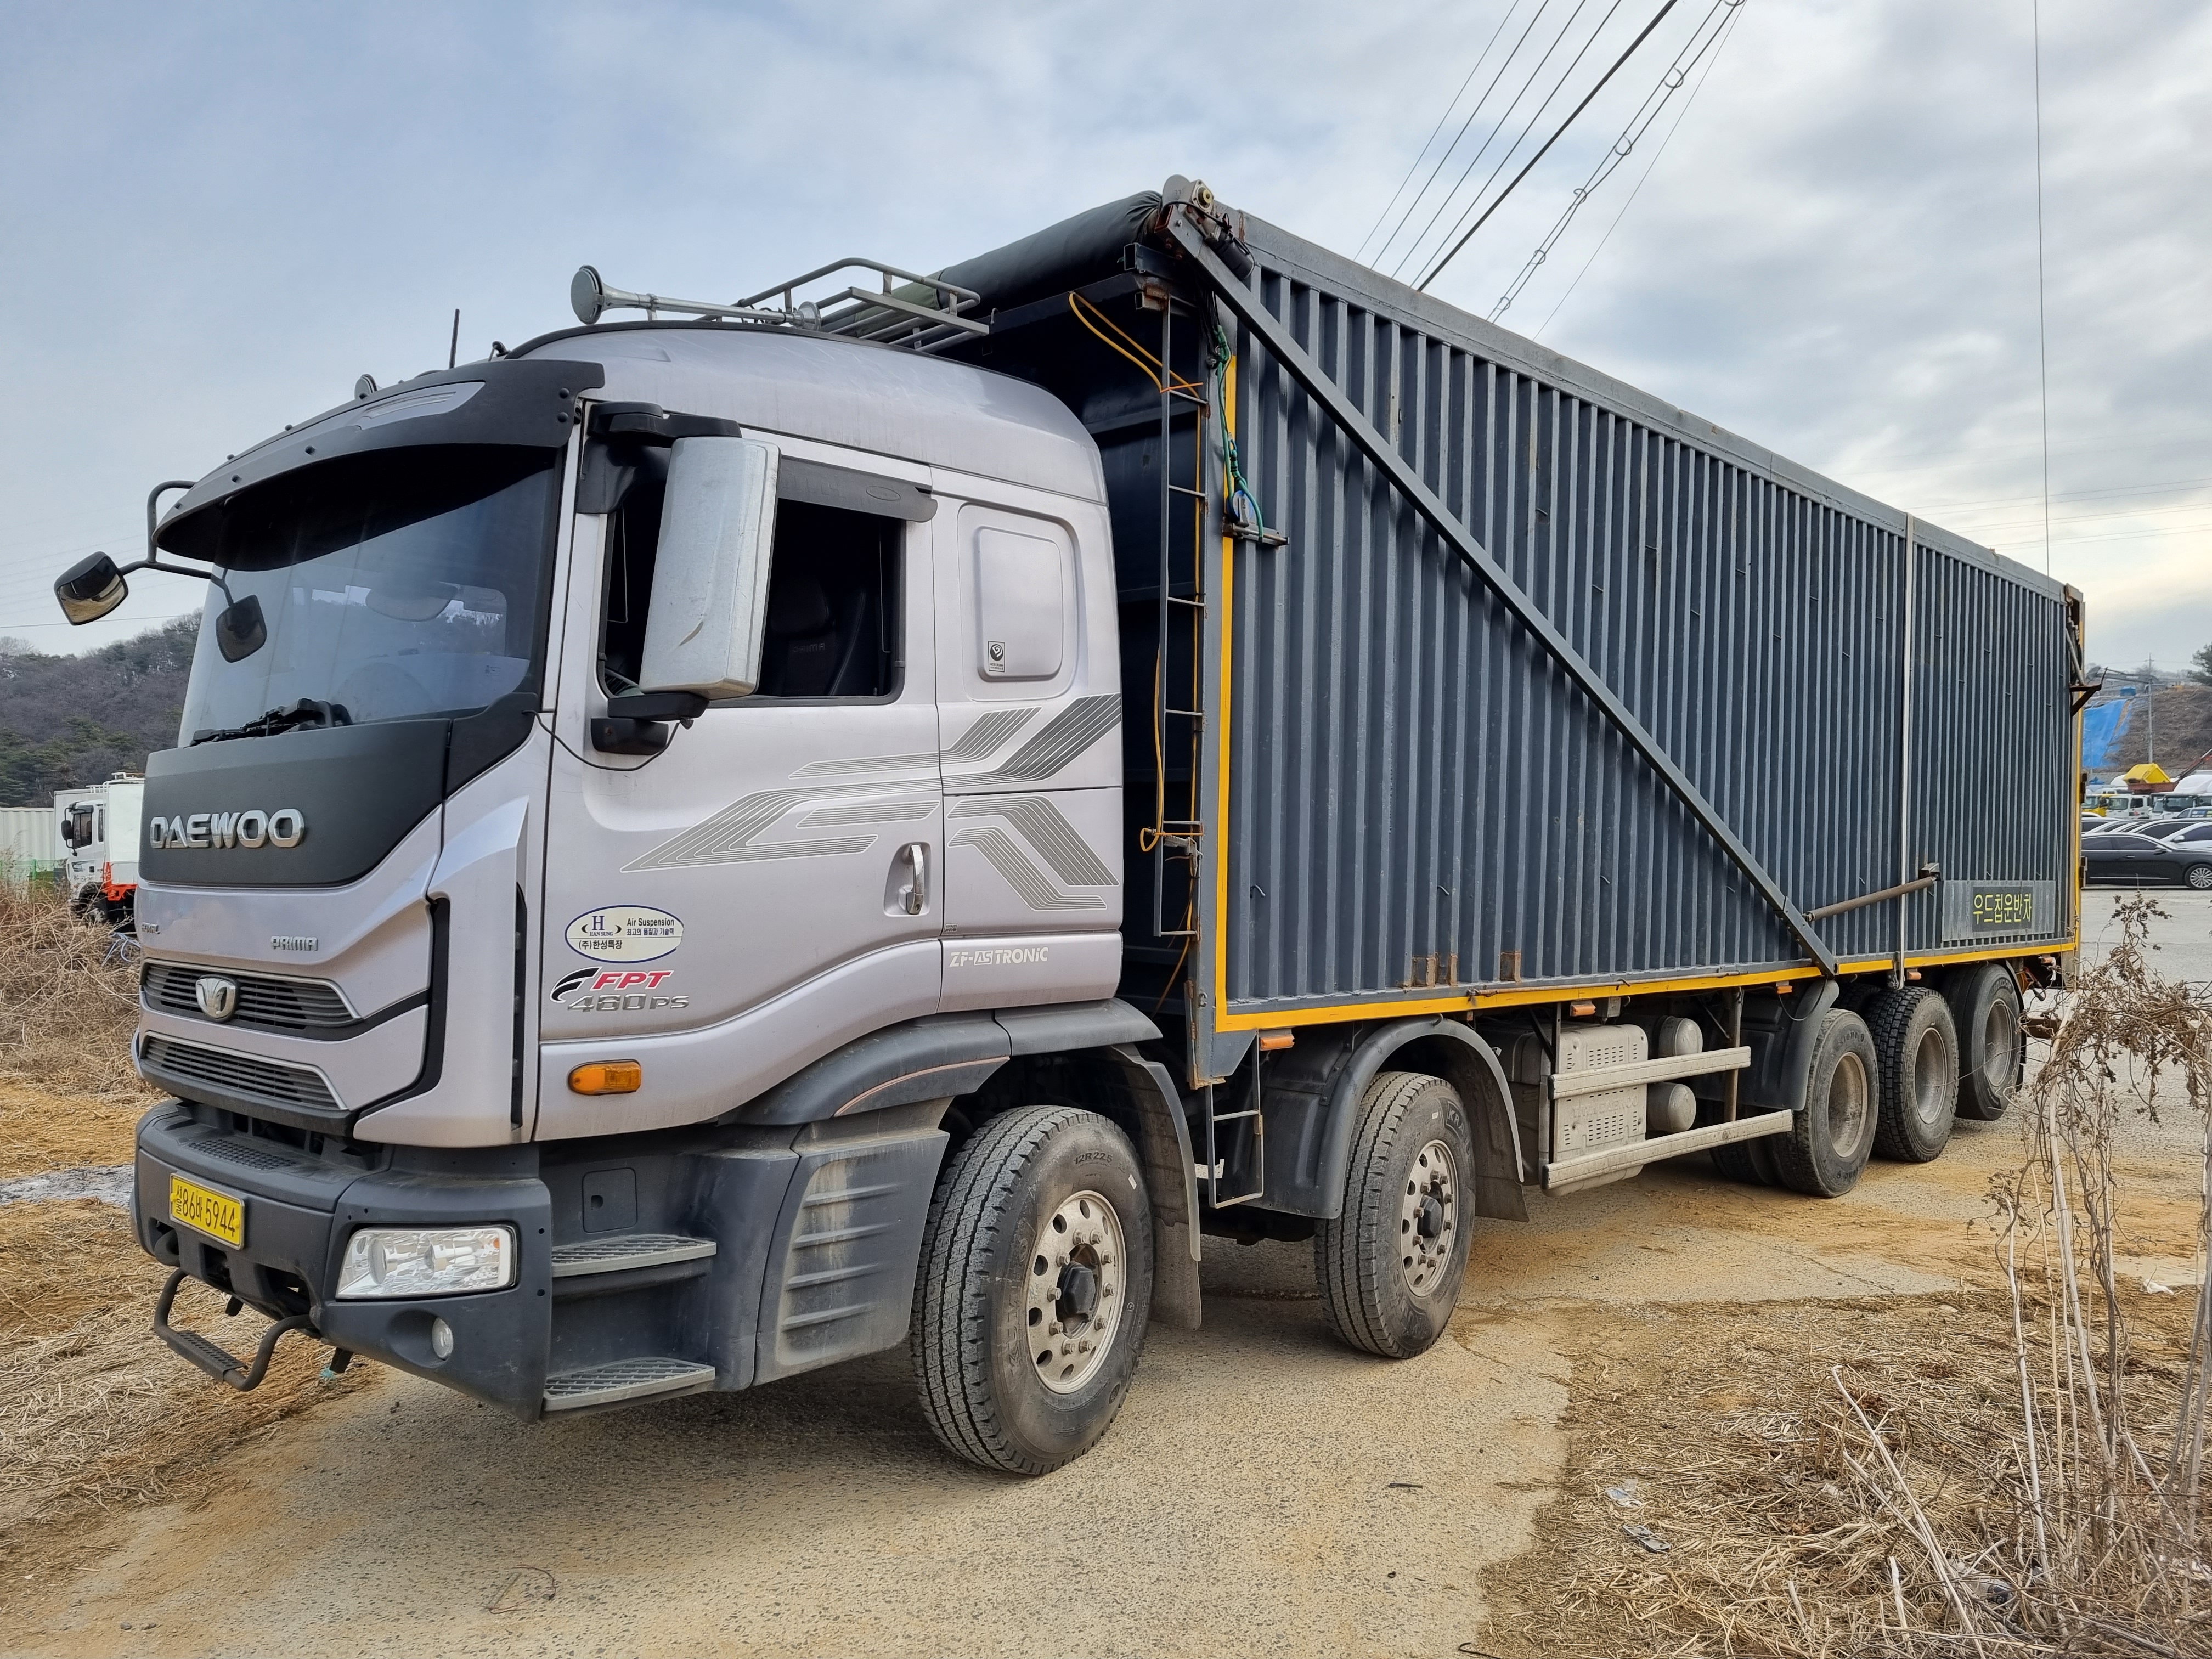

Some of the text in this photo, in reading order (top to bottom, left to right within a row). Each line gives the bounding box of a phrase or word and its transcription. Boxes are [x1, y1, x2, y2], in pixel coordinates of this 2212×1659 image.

[150, 809, 304, 849] DAEWOO
[1973, 893, 2032, 925] 우드칩운반차
[591, 915, 605, 930] H
[627, 917, 674, 927] Air Suspension
[270, 935, 318, 951] PRIMA
[579, 940, 623, 950] (주)한성특장
[590, 970, 673, 990] FPT
[176, 1185, 182, 1215] 서울
[206, 1198, 235, 1237] 5944
